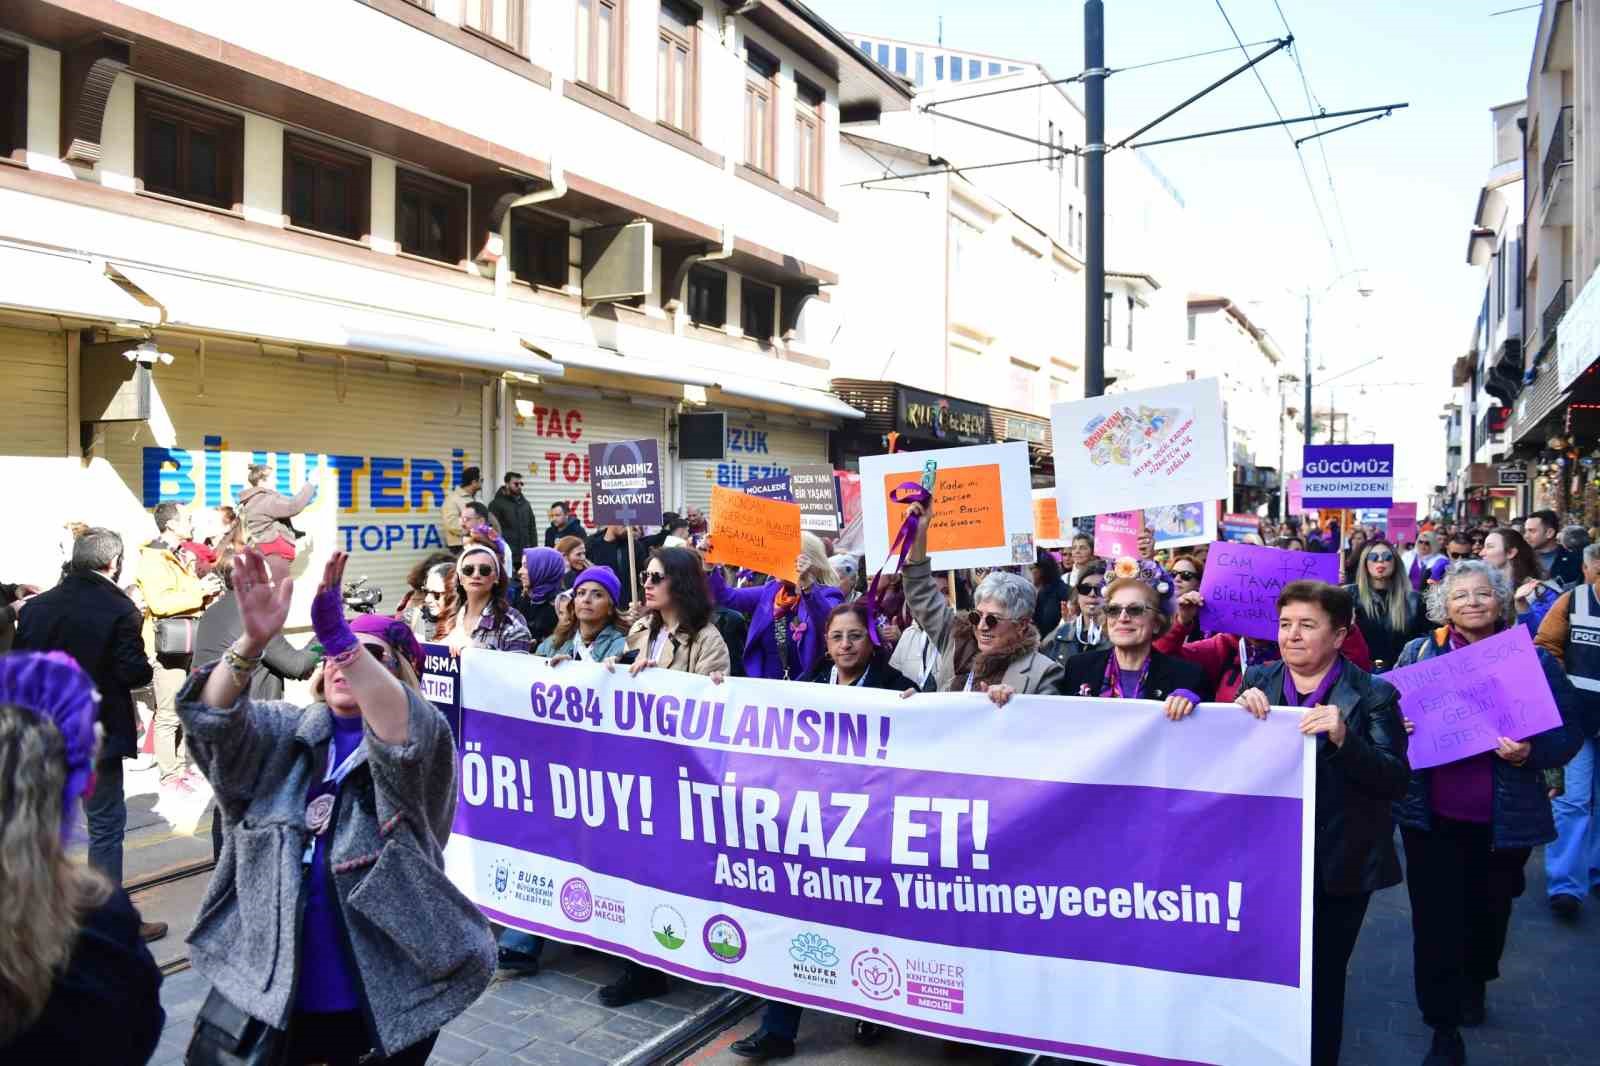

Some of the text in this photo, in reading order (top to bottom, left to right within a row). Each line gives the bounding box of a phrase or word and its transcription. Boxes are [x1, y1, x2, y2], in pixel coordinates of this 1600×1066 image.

[534, 406, 583, 443] TAÇ
[727, 423, 768, 454] ZÜK
[595, 462, 653, 477] HAKLARIMIZ
[1306, 460, 1390, 474] GÜCÜMÜZ
[1305, 482, 1389, 493] KENDİMİZDEN!
[597, 492, 656, 505] SOKAKTAYIZ!
[1216, 553, 1253, 569] CAM
[530, 681, 603, 727] 6284
[548, 763, 654, 836] DUY!
[677, 766, 869, 862] İTİRAZ
[890, 796, 990, 871] ET!
[518, 871, 555, 889] BURSA
[714, 853, 776, 894] Asla
[783, 862, 884, 906] Yalnız
[594, 900, 625, 914] KADIN
[920, 984, 949, 997] KADIN
